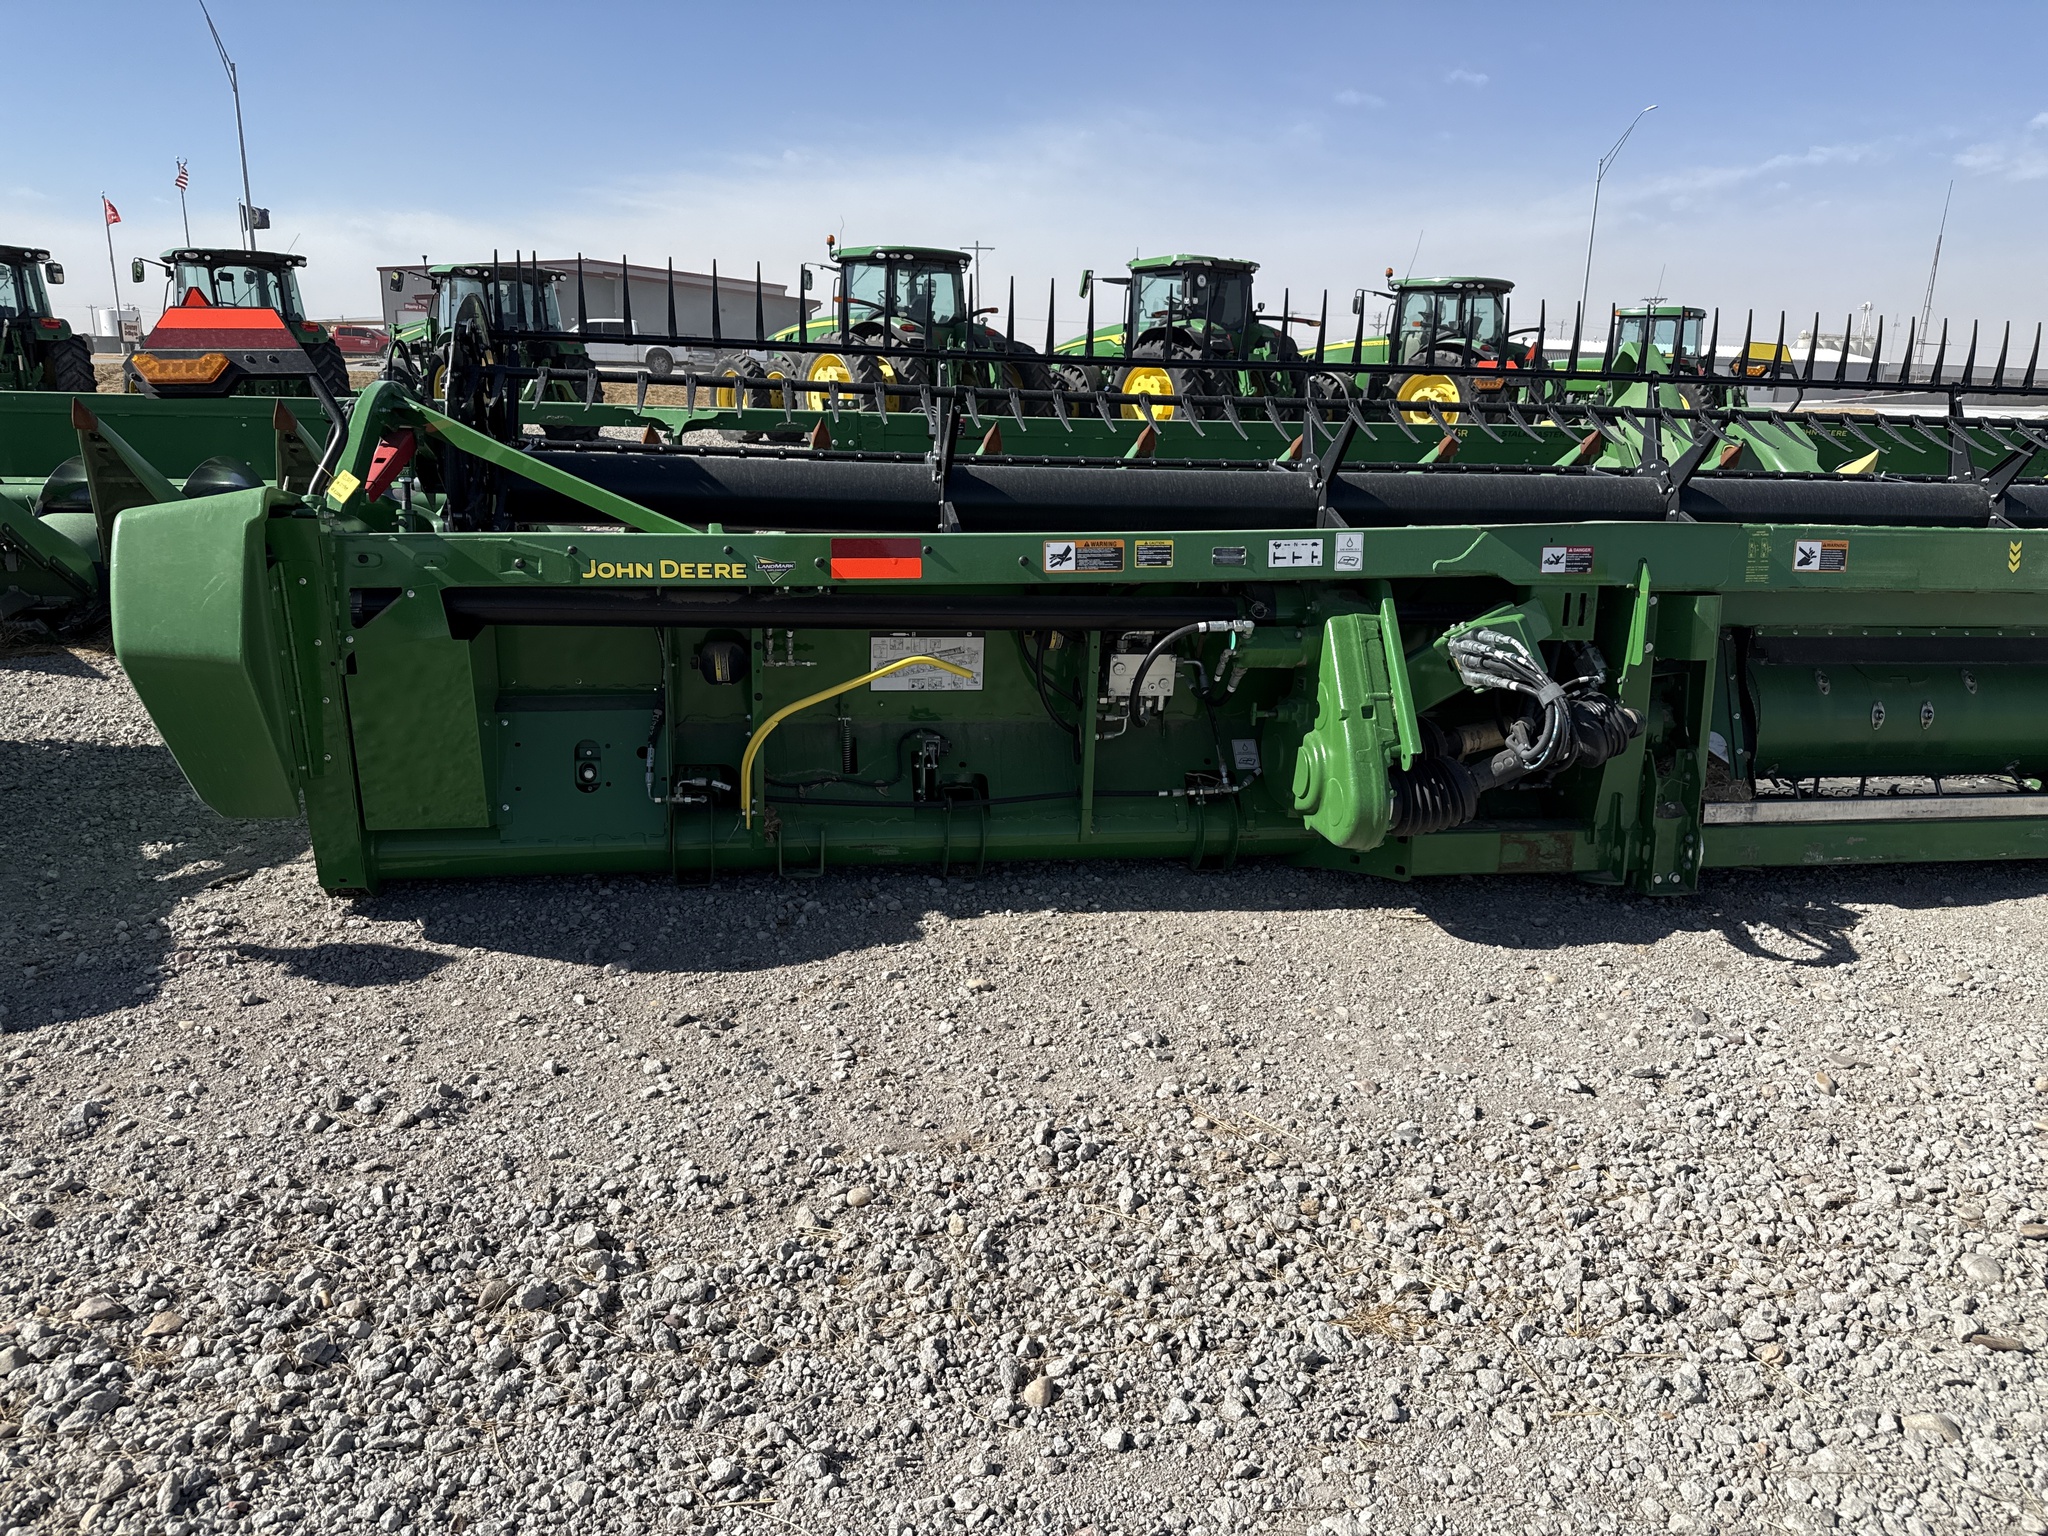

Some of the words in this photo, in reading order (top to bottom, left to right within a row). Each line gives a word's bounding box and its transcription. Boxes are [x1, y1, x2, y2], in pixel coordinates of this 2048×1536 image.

[1501, 430, 1566, 438] STALKASTER
[582, 559, 653, 579] JOHN
[659, 559, 747, 579] DEERE
